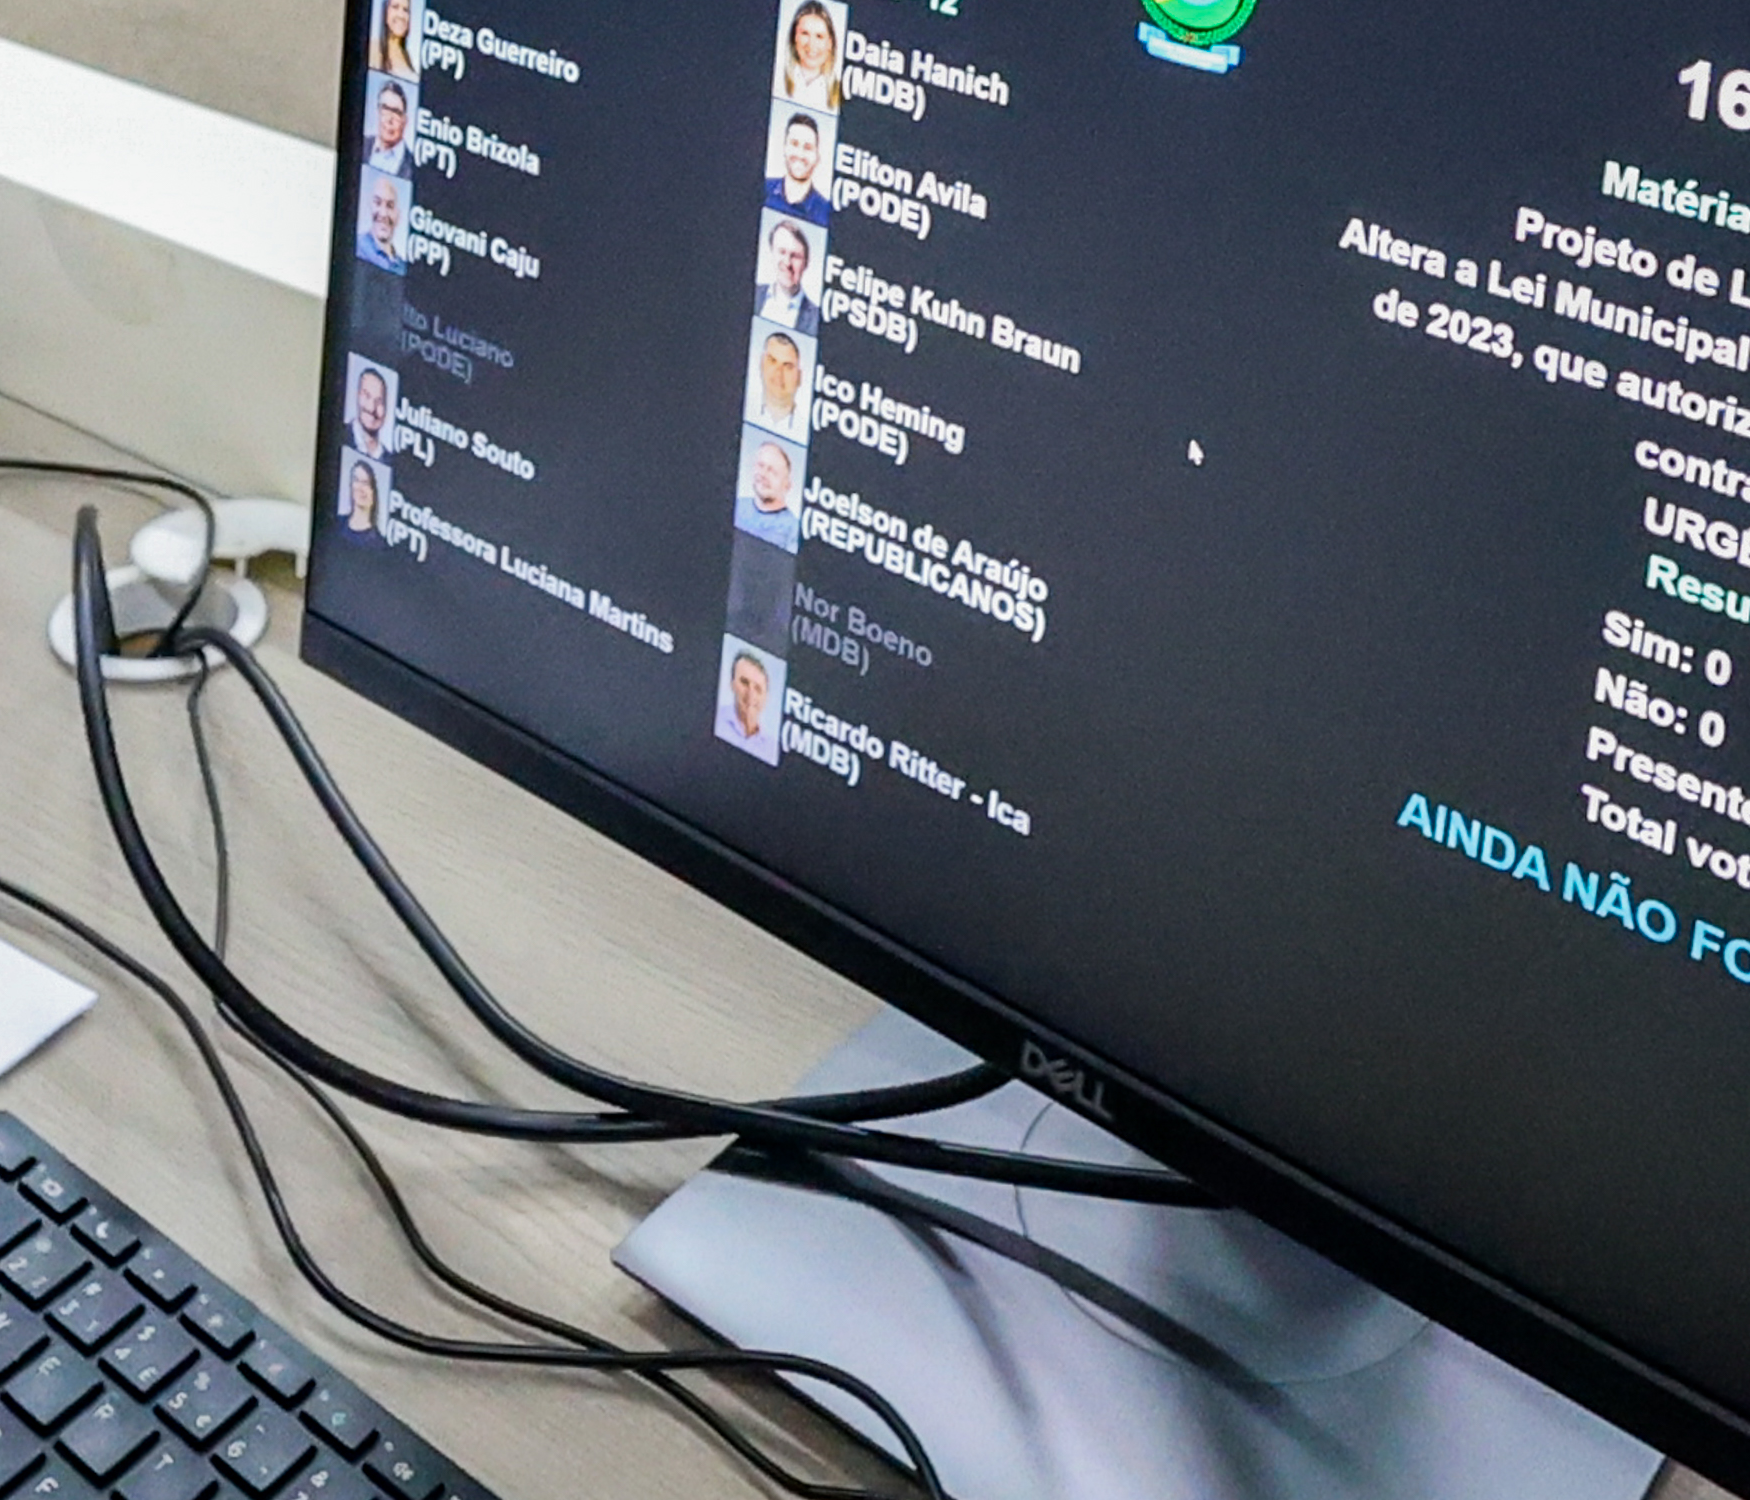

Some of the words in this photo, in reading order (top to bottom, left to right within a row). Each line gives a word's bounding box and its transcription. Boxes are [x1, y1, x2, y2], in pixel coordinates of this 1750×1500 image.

[421, 39, 465, 80] (PP)
[422, 10, 474, 49] Deza
[476, 27, 580, 84] Guerreiro
[845, 30, 906, 76] Daia
[910, 48, 1010, 107] Hanich
[842, 64, 928, 122] (MDB)
[414, 140, 457, 179] (PT)
[415, 107, 463, 144] Enio
[466, 124, 541, 176] Brizola
[832, 176, 932, 240] (PODE)
[834, 142, 914, 196] Eliton
[916, 171, 988, 220] Avila
[407, 233, 451, 276] (PP)
[409, 205, 487, 257] Giovani
[490, 237, 541, 279] Caju
[1515, 207, 1658, 277] Projeto
[1667, 254, 1719, 296] de
[821, 287, 919, 354] (PSDB)
[825, 254, 906, 310] Felipe
[910, 284, 987, 340] Kuhn
[991, 314, 1082, 375] Braun
[1339, 218, 1446, 278] Altera
[1455, 259, 1478, 288] a
[1488, 260, 1547, 308] Lei
[1555, 280, 1750, 371] Municipal
[401, 331, 472, 384] (PODE)
[433, 314, 514, 368] Luciano
[1373, 289, 1419, 328] de
[1426, 303, 1523, 368] 2023,
[1533, 345, 1607, 389] que
[395, 397, 469, 449] Juliano
[471, 431, 536, 481] Souto
[811, 397, 909, 466] (PODE)
[814, 363, 856, 401] Ico
[859, 381, 966, 455] Heming
[393, 425, 435, 468] (PL)
[387, 519, 428, 563] (PT)
[388, 489, 498, 565] Professora
[500, 545, 585, 611] Luciana
[588, 588, 675, 654] Martins
[800, 507, 1048, 644] (REPUBLICANOS)
[803, 476, 909, 543] Joelson
[911, 523, 949, 560] de
[951, 539, 1048, 603] Araújo
[790, 614, 870, 677] (MDB)
[794, 581, 840, 623] Nor
[847, 605, 933, 668] Boeno
[1603, 611, 1693, 673] Sim:
[1705, 650, 1731, 686] 0
[1595, 668, 1687, 734] Não:
[1699, 711, 1725, 747] 0
[779, 719, 861, 787] (MDB)
[783, 687, 885, 760] Ricardo
[887, 740, 968, 802] Ritter
[986, 790, 1031, 837] Ica
[1581, 784, 1677, 854] Total
[1397, 793, 1550, 891] AINDA
[1563, 862, 1676, 942] NÃO
[1020, 1038, 1117, 1122] DELL
[38, 1354, 62, 1376] E
[94, 1401, 116, 1422] R
